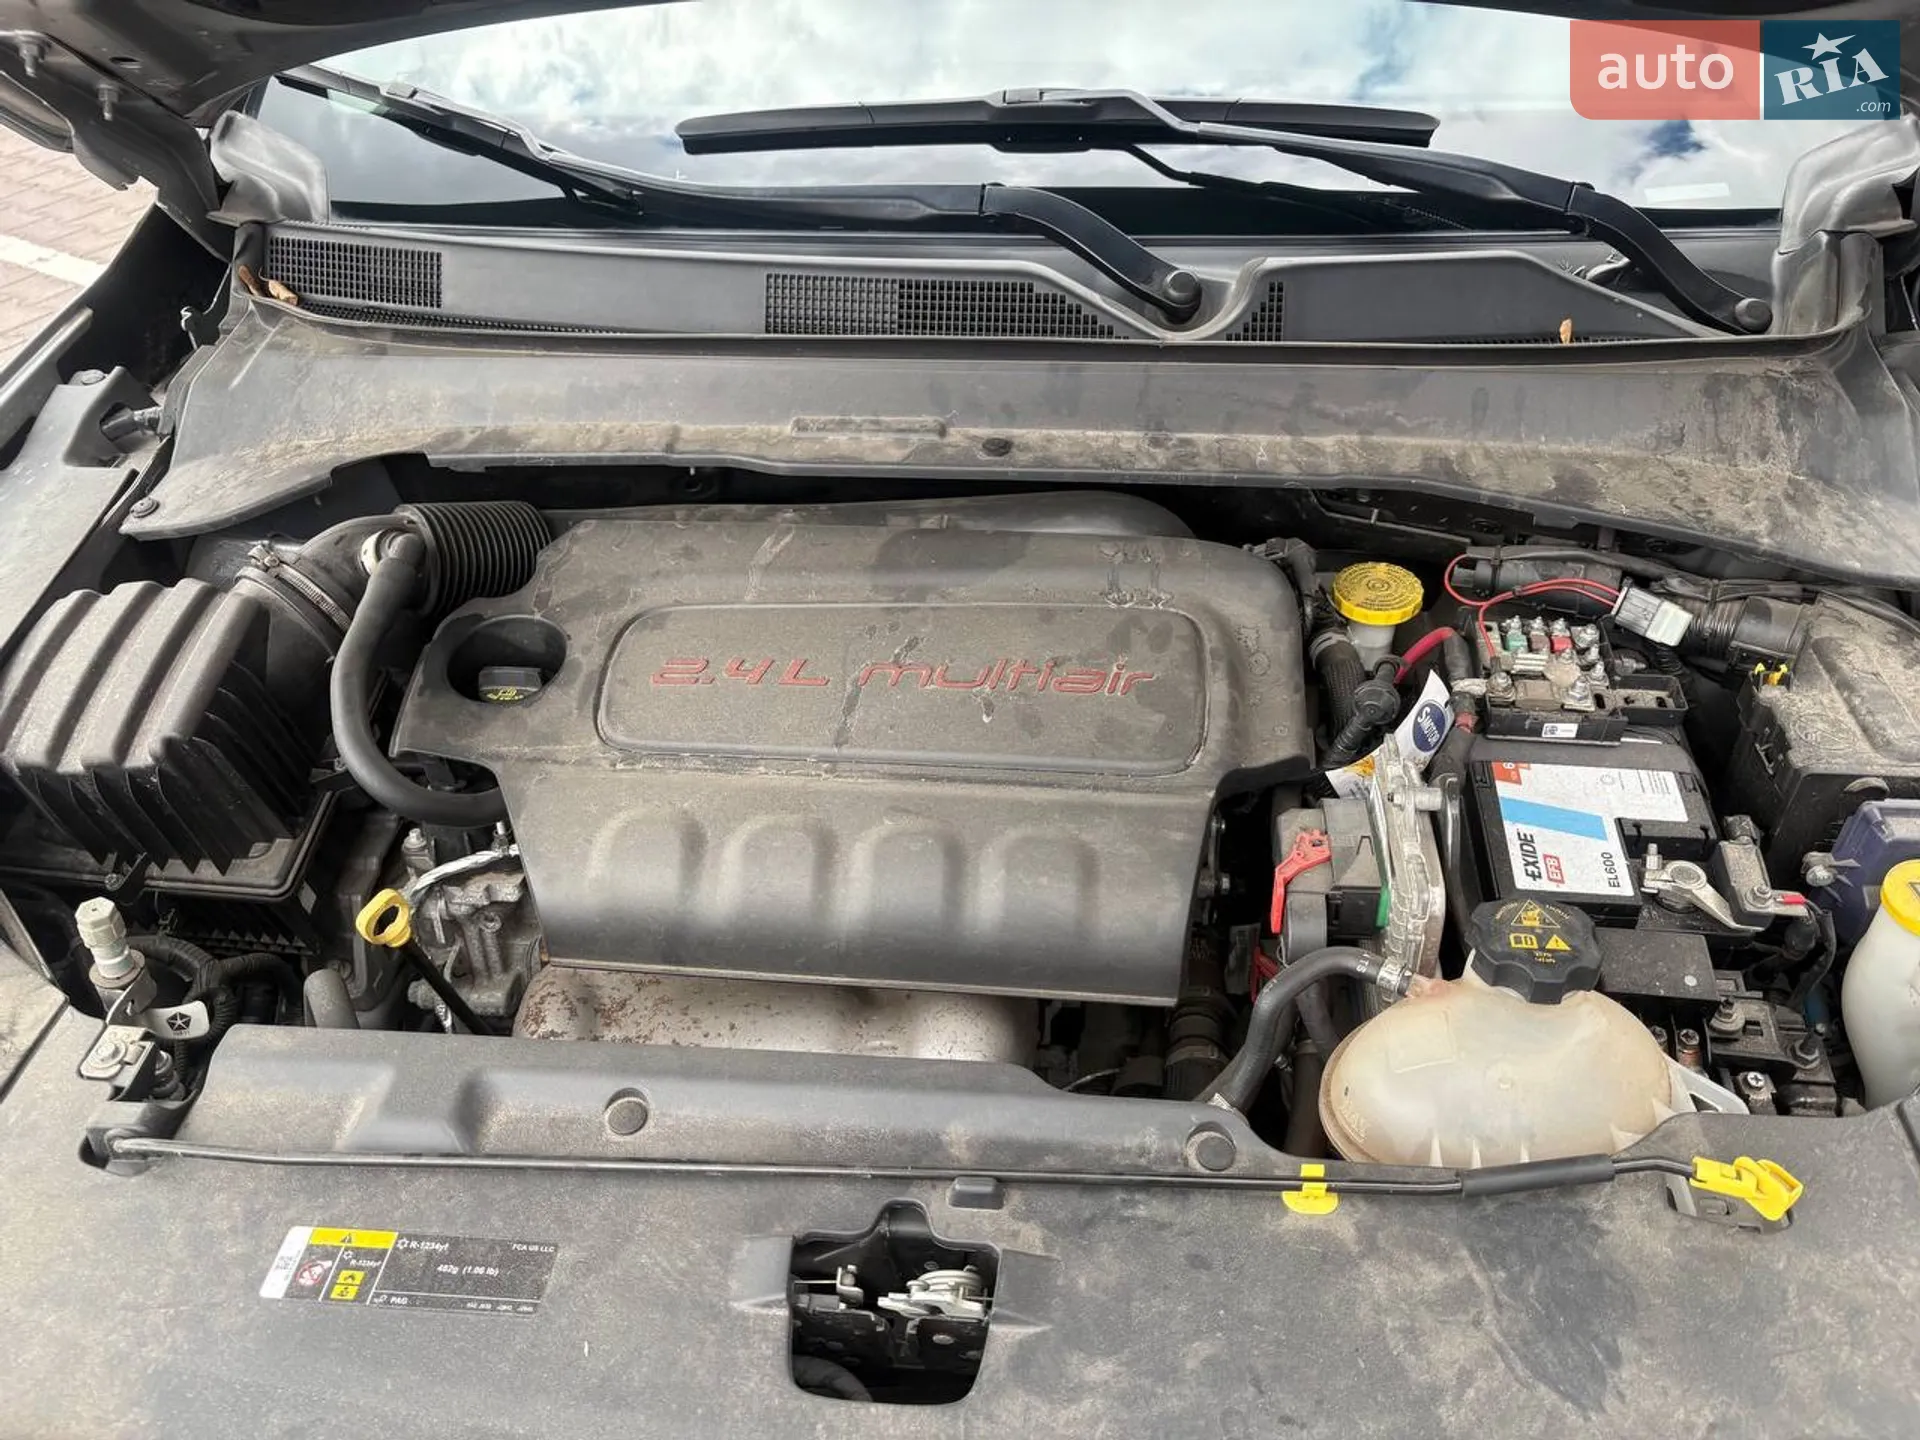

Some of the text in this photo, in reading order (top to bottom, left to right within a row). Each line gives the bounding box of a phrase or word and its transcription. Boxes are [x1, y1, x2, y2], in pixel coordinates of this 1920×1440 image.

[857, 653, 1156, 696] multiair
[1517, 831, 1543, 882] EXIDE
[1545, 857, 1562, 880] EFB
[1600, 851, 1621, 888] EL600
[409, 1241, 450, 1252] R-1234yf
